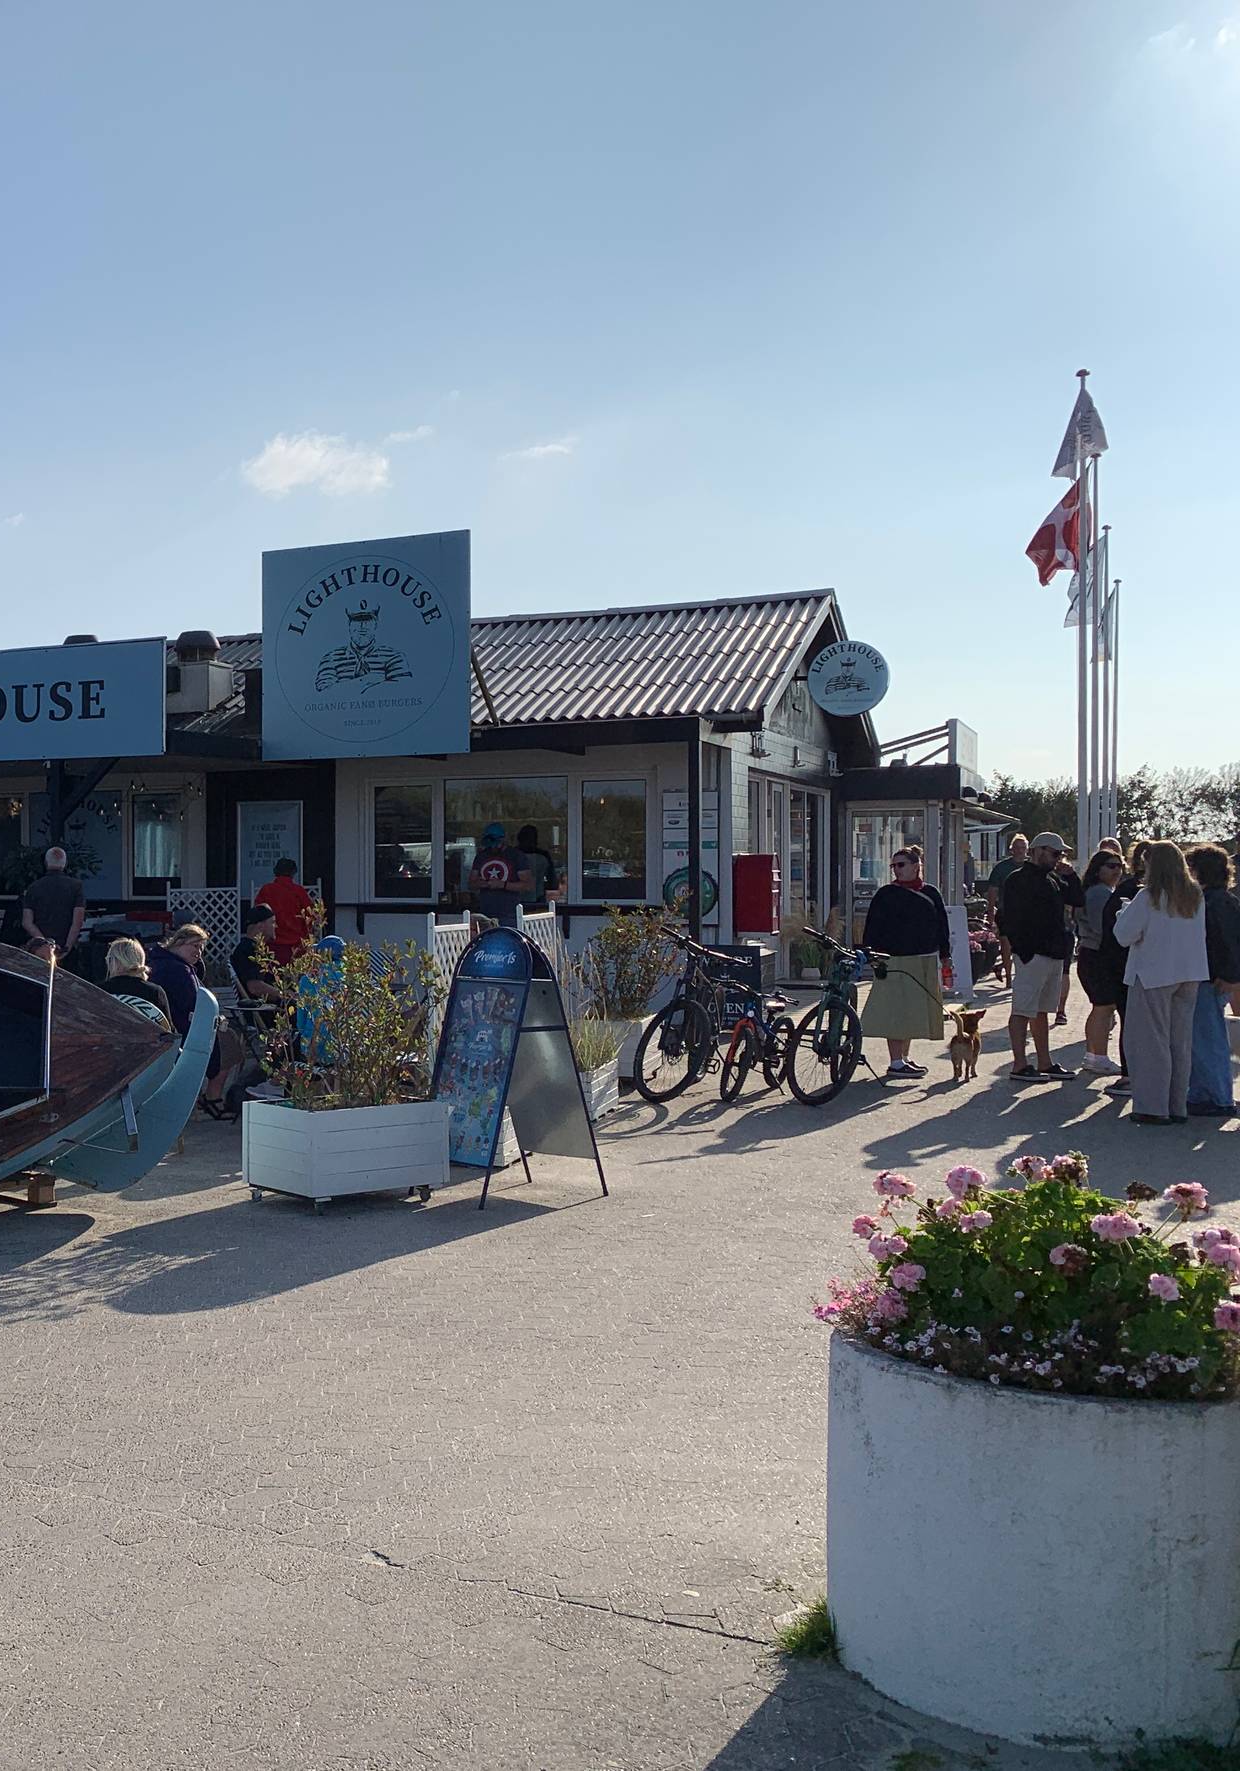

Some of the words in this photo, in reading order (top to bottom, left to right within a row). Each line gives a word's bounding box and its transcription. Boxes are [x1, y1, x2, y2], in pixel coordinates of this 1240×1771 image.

[287, 564, 442, 637] LIGHTHOUSE
[811, 643, 885, 674] LIGHTHOUSE
[707, 1002, 745, 1014] OEN
